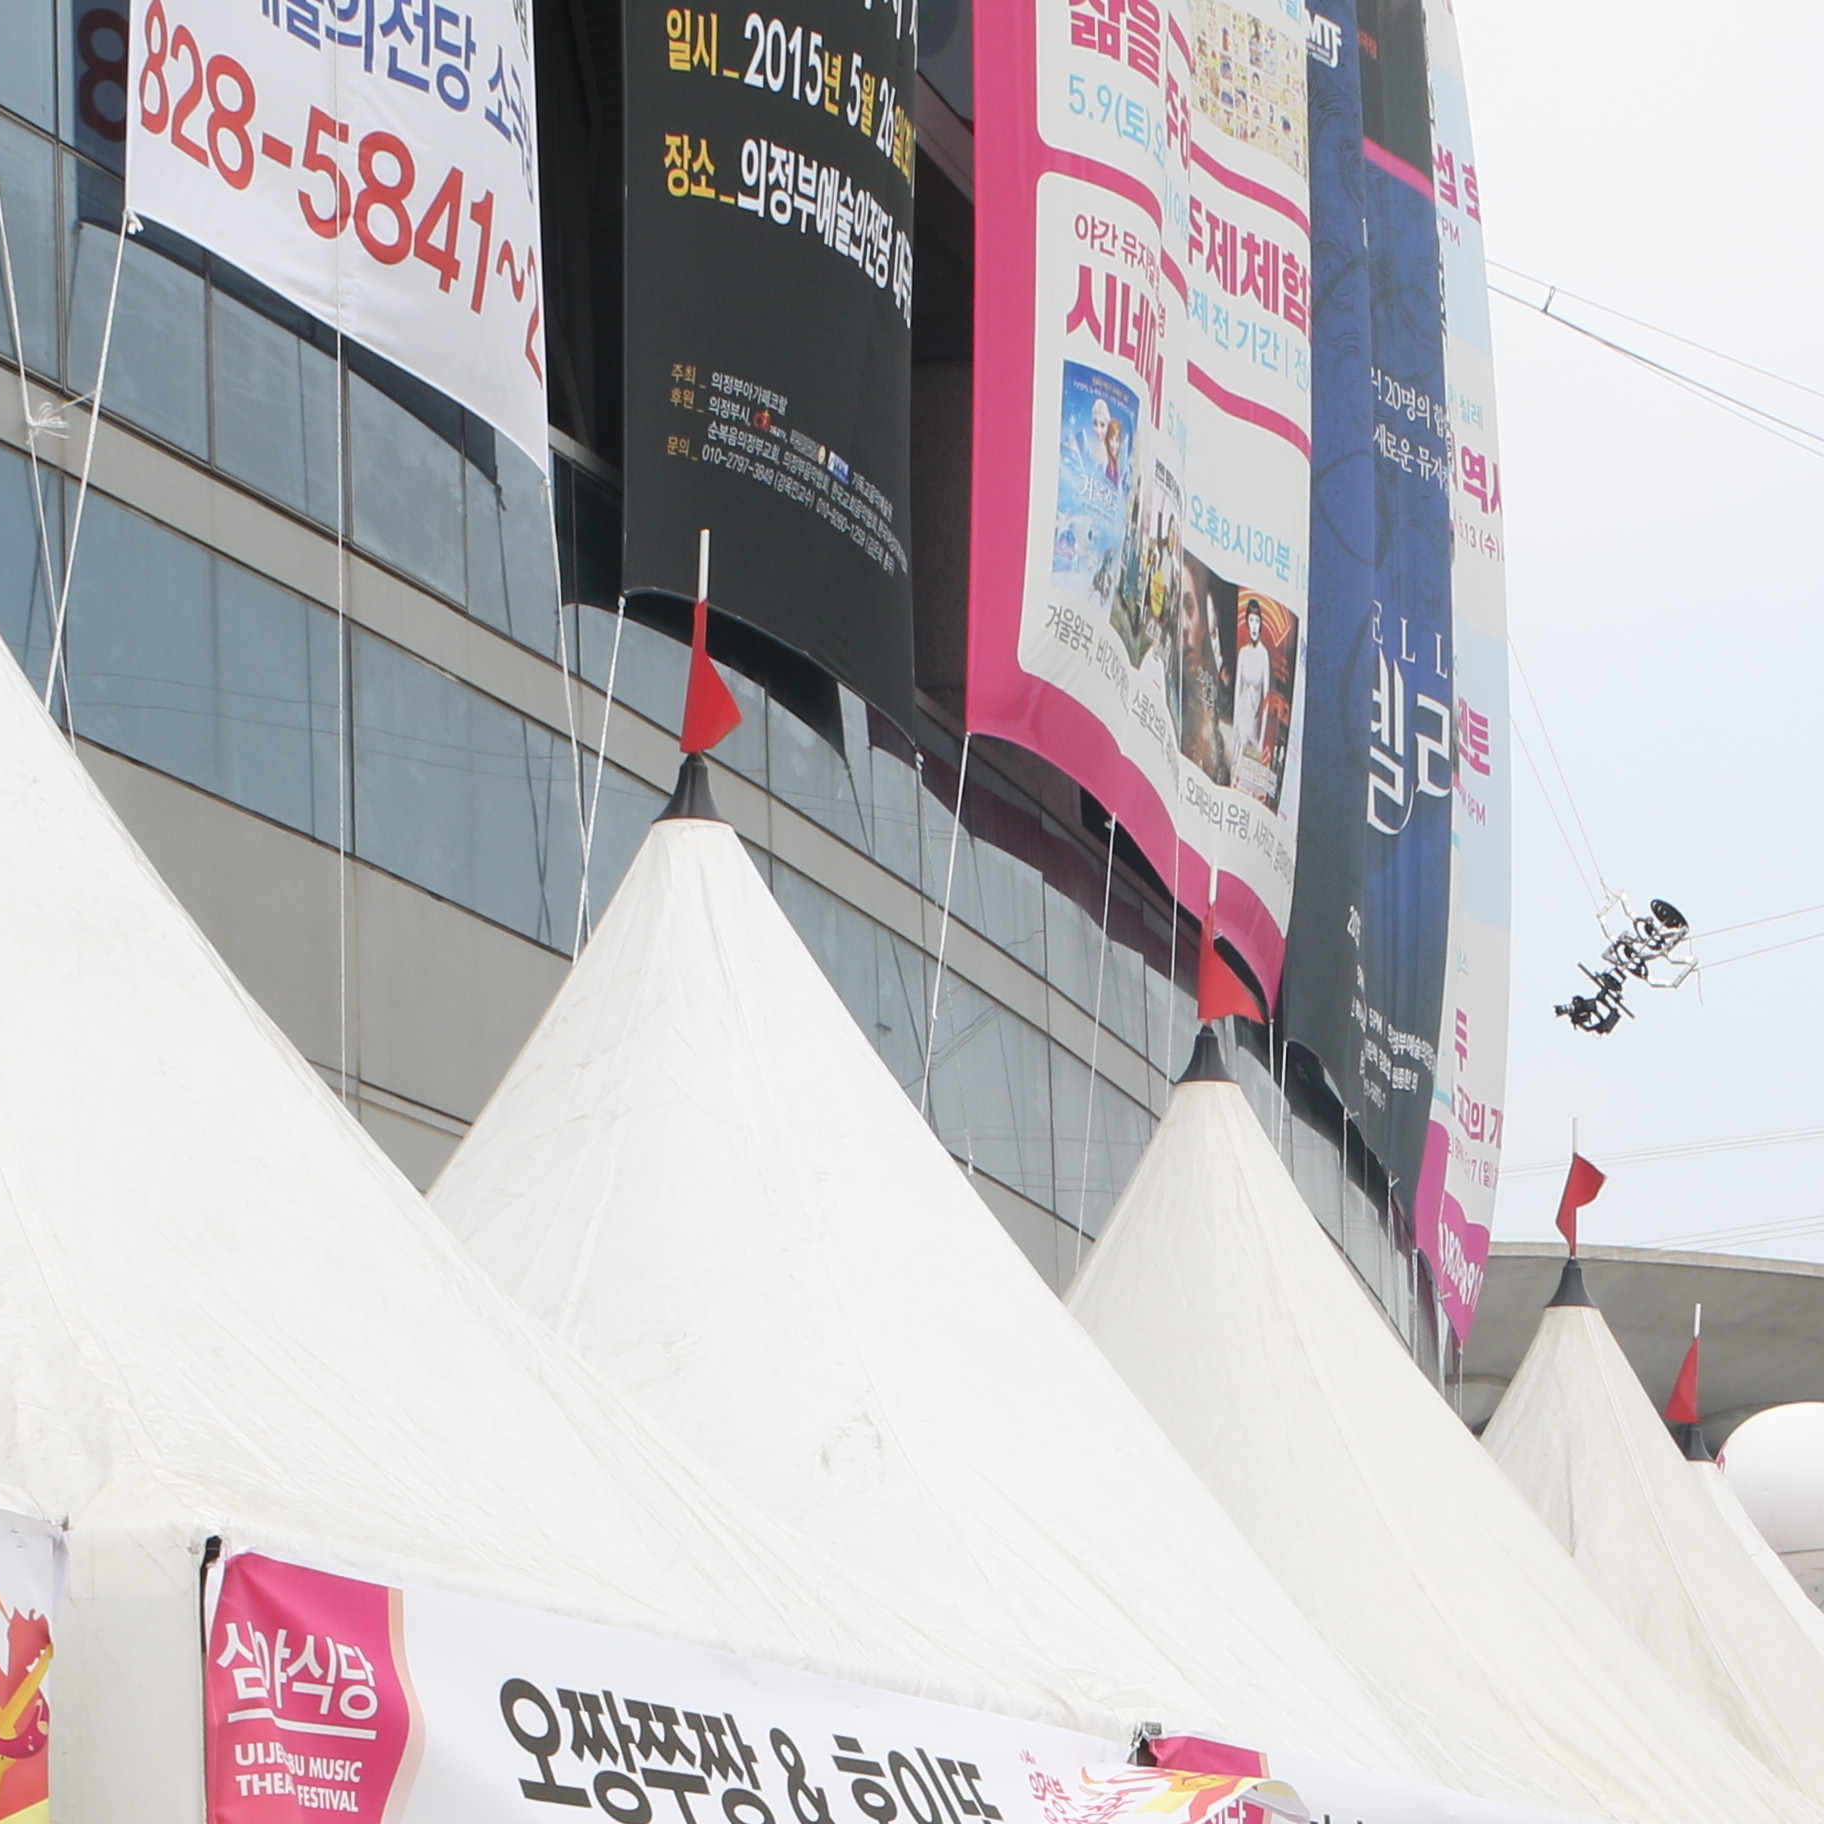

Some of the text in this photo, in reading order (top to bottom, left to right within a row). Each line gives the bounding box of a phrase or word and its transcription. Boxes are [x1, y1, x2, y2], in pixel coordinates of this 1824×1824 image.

[846, 52, 875, 137] 5월
[1068, 73, 1151, 153] 5.9(토)
[737, 138, 894, 289] 의정부예술의전당
[1074, 213, 1118, 258] 야간
[1235, 319, 1280, 372] 기간
[1384, 375, 1430, 430] 20명의
[1372, 422, 1415, 474] 새로운
[1189, 494, 1292, 583] 오후8시30분
[215, 1620, 379, 1721] 심야식당
[308, 1756, 363, 1783] MUSIC
[296, 1784, 360, 1813] FESTIVAL
